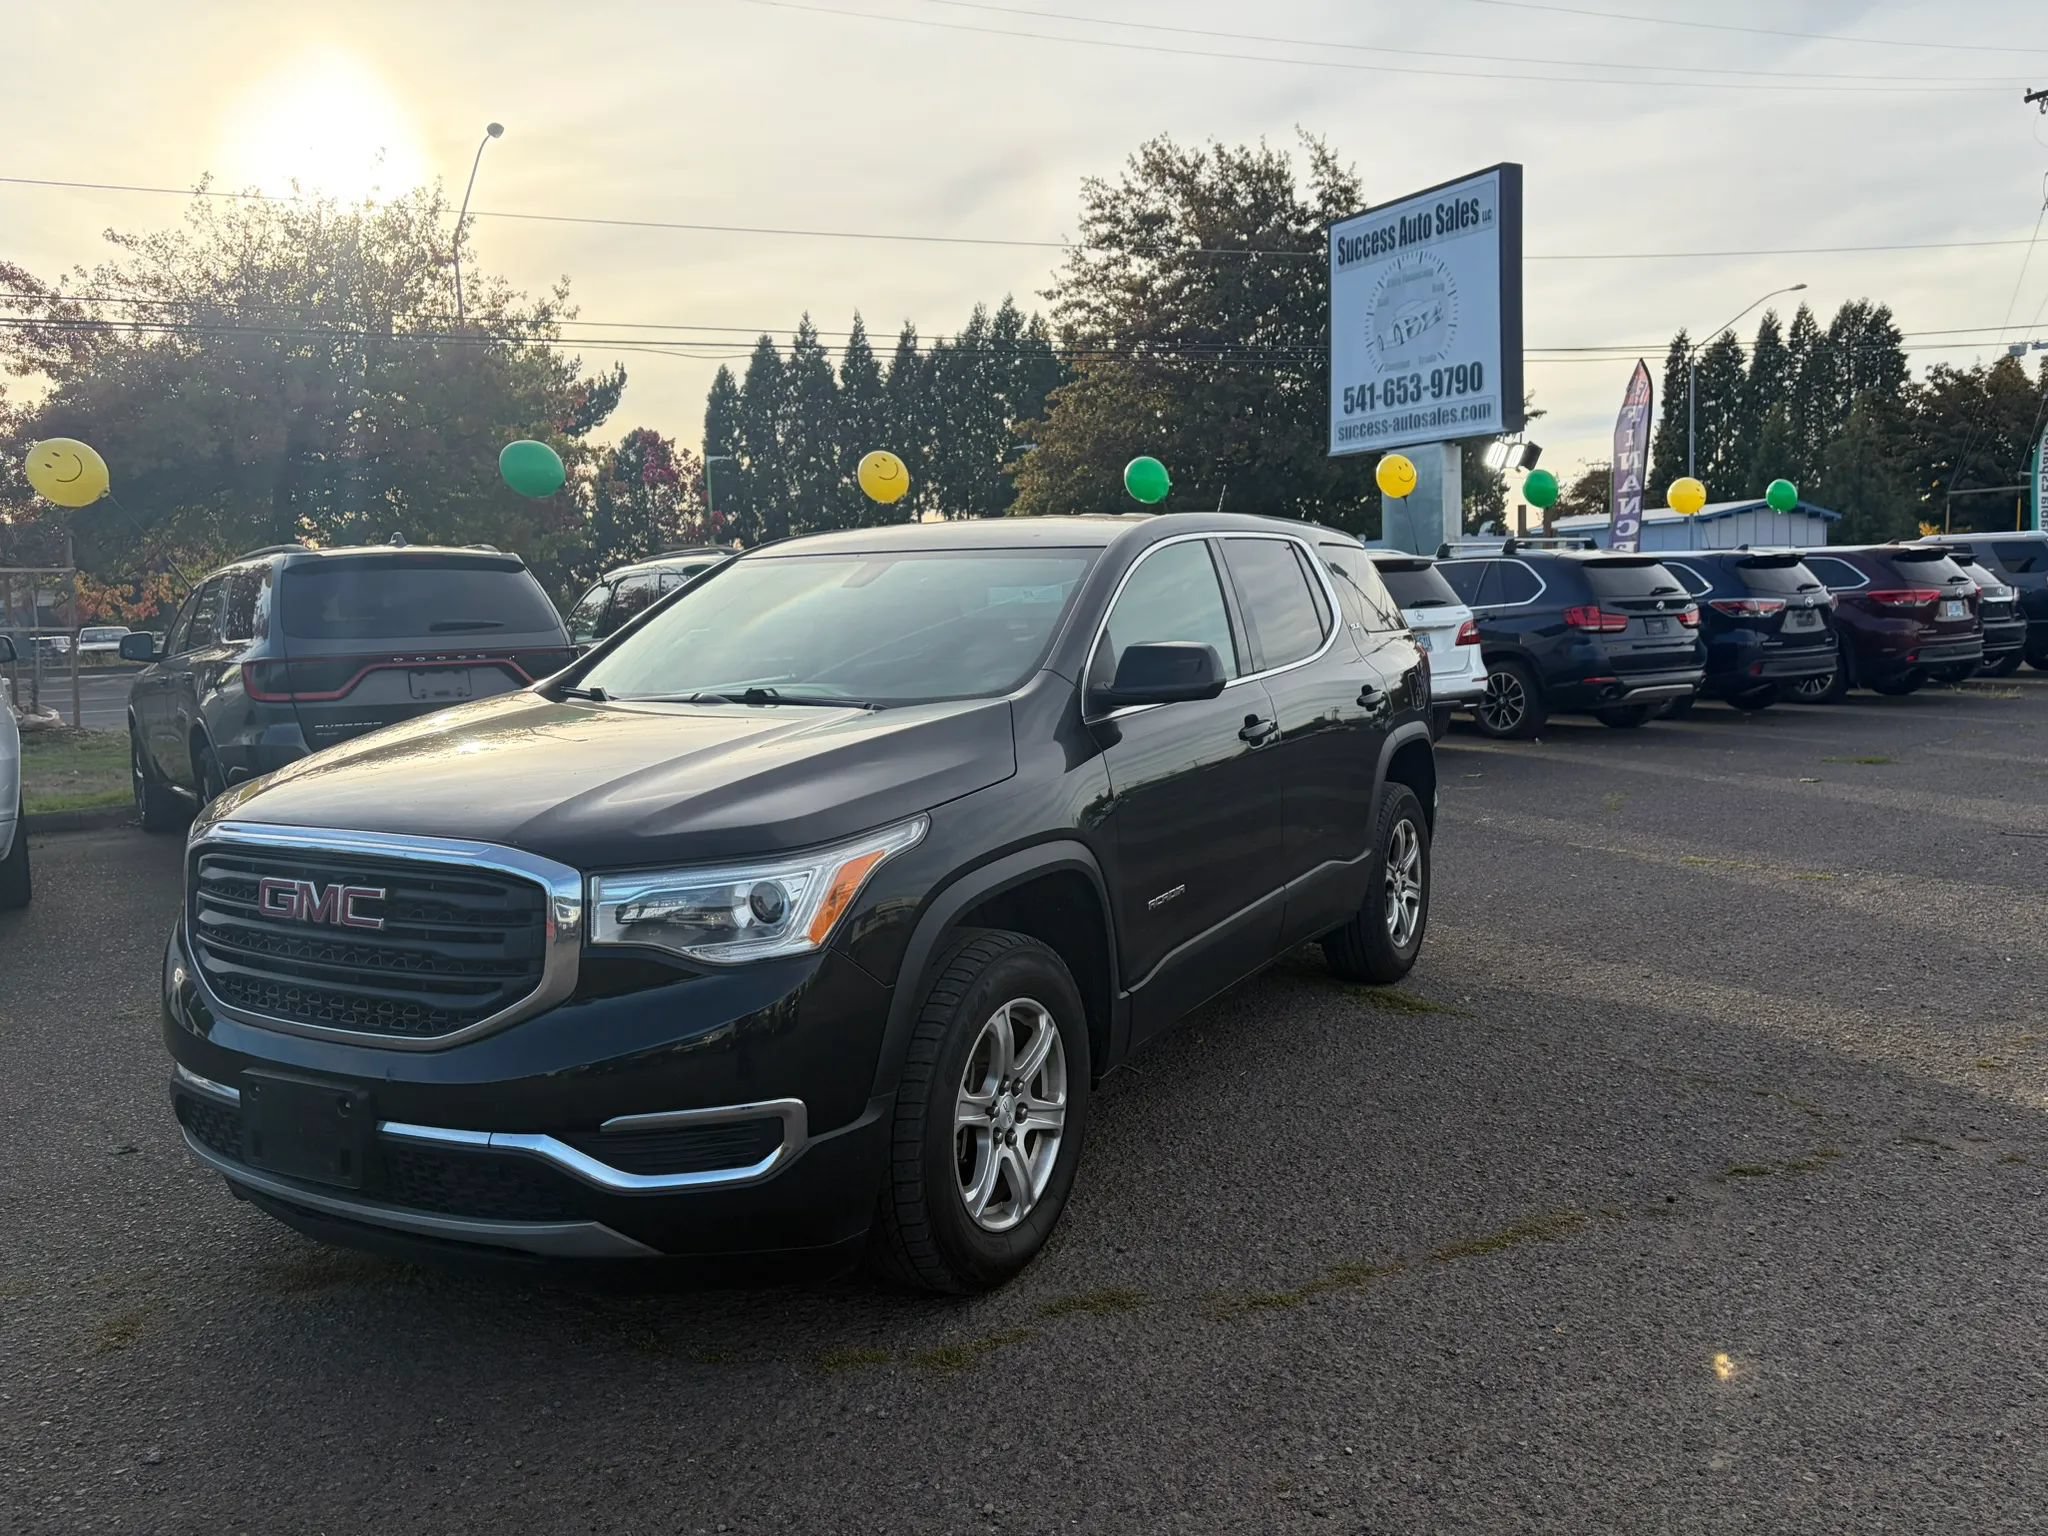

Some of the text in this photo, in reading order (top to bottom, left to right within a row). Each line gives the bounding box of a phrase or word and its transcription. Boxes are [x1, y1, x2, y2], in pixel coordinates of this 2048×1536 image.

[1337, 198, 1492, 266] Success Auto Sales LLC
[1343, 361, 1483, 415] 541-653-9790
[1337, 403, 1492, 442] success-autosales.com
[259, 877, 386, 930] GMC
